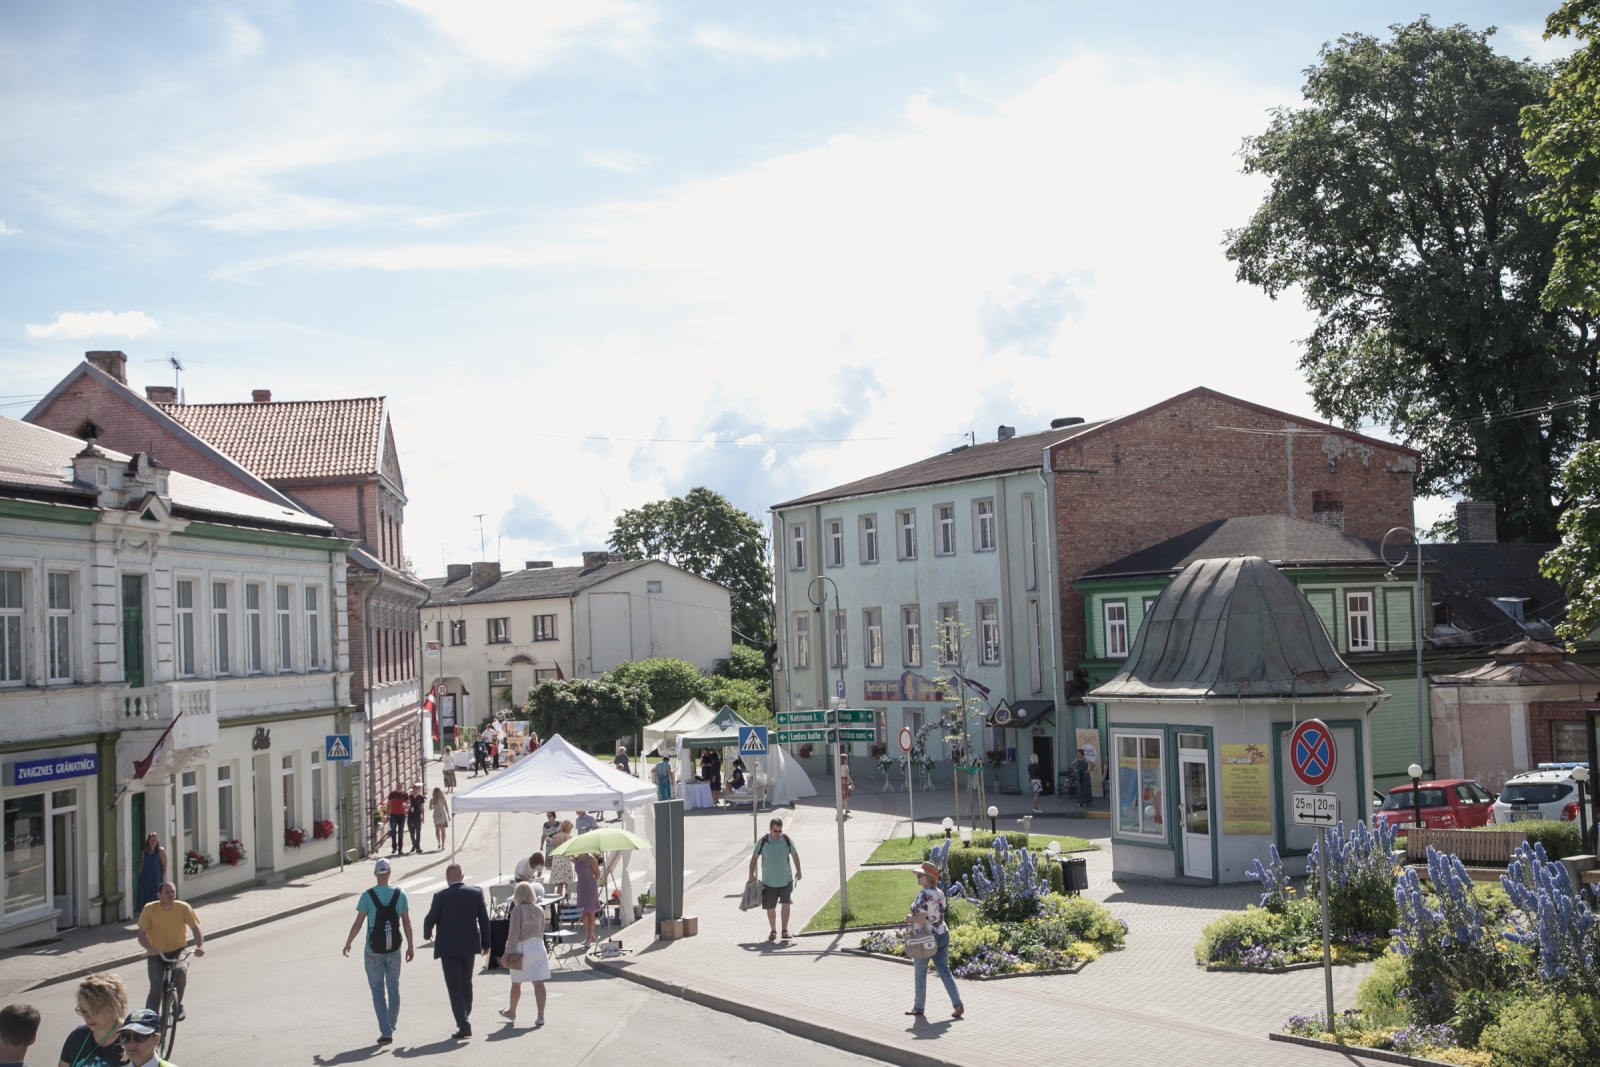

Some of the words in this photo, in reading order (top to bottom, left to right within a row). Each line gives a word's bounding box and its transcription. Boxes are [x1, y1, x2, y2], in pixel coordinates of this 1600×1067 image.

[790, 732, 807, 741] Ledus
[807, 731, 821, 740] halle
[18, 765, 53, 779] ZVAIGZNES
[55, 759, 95, 774] GRĀMATNĪCA
